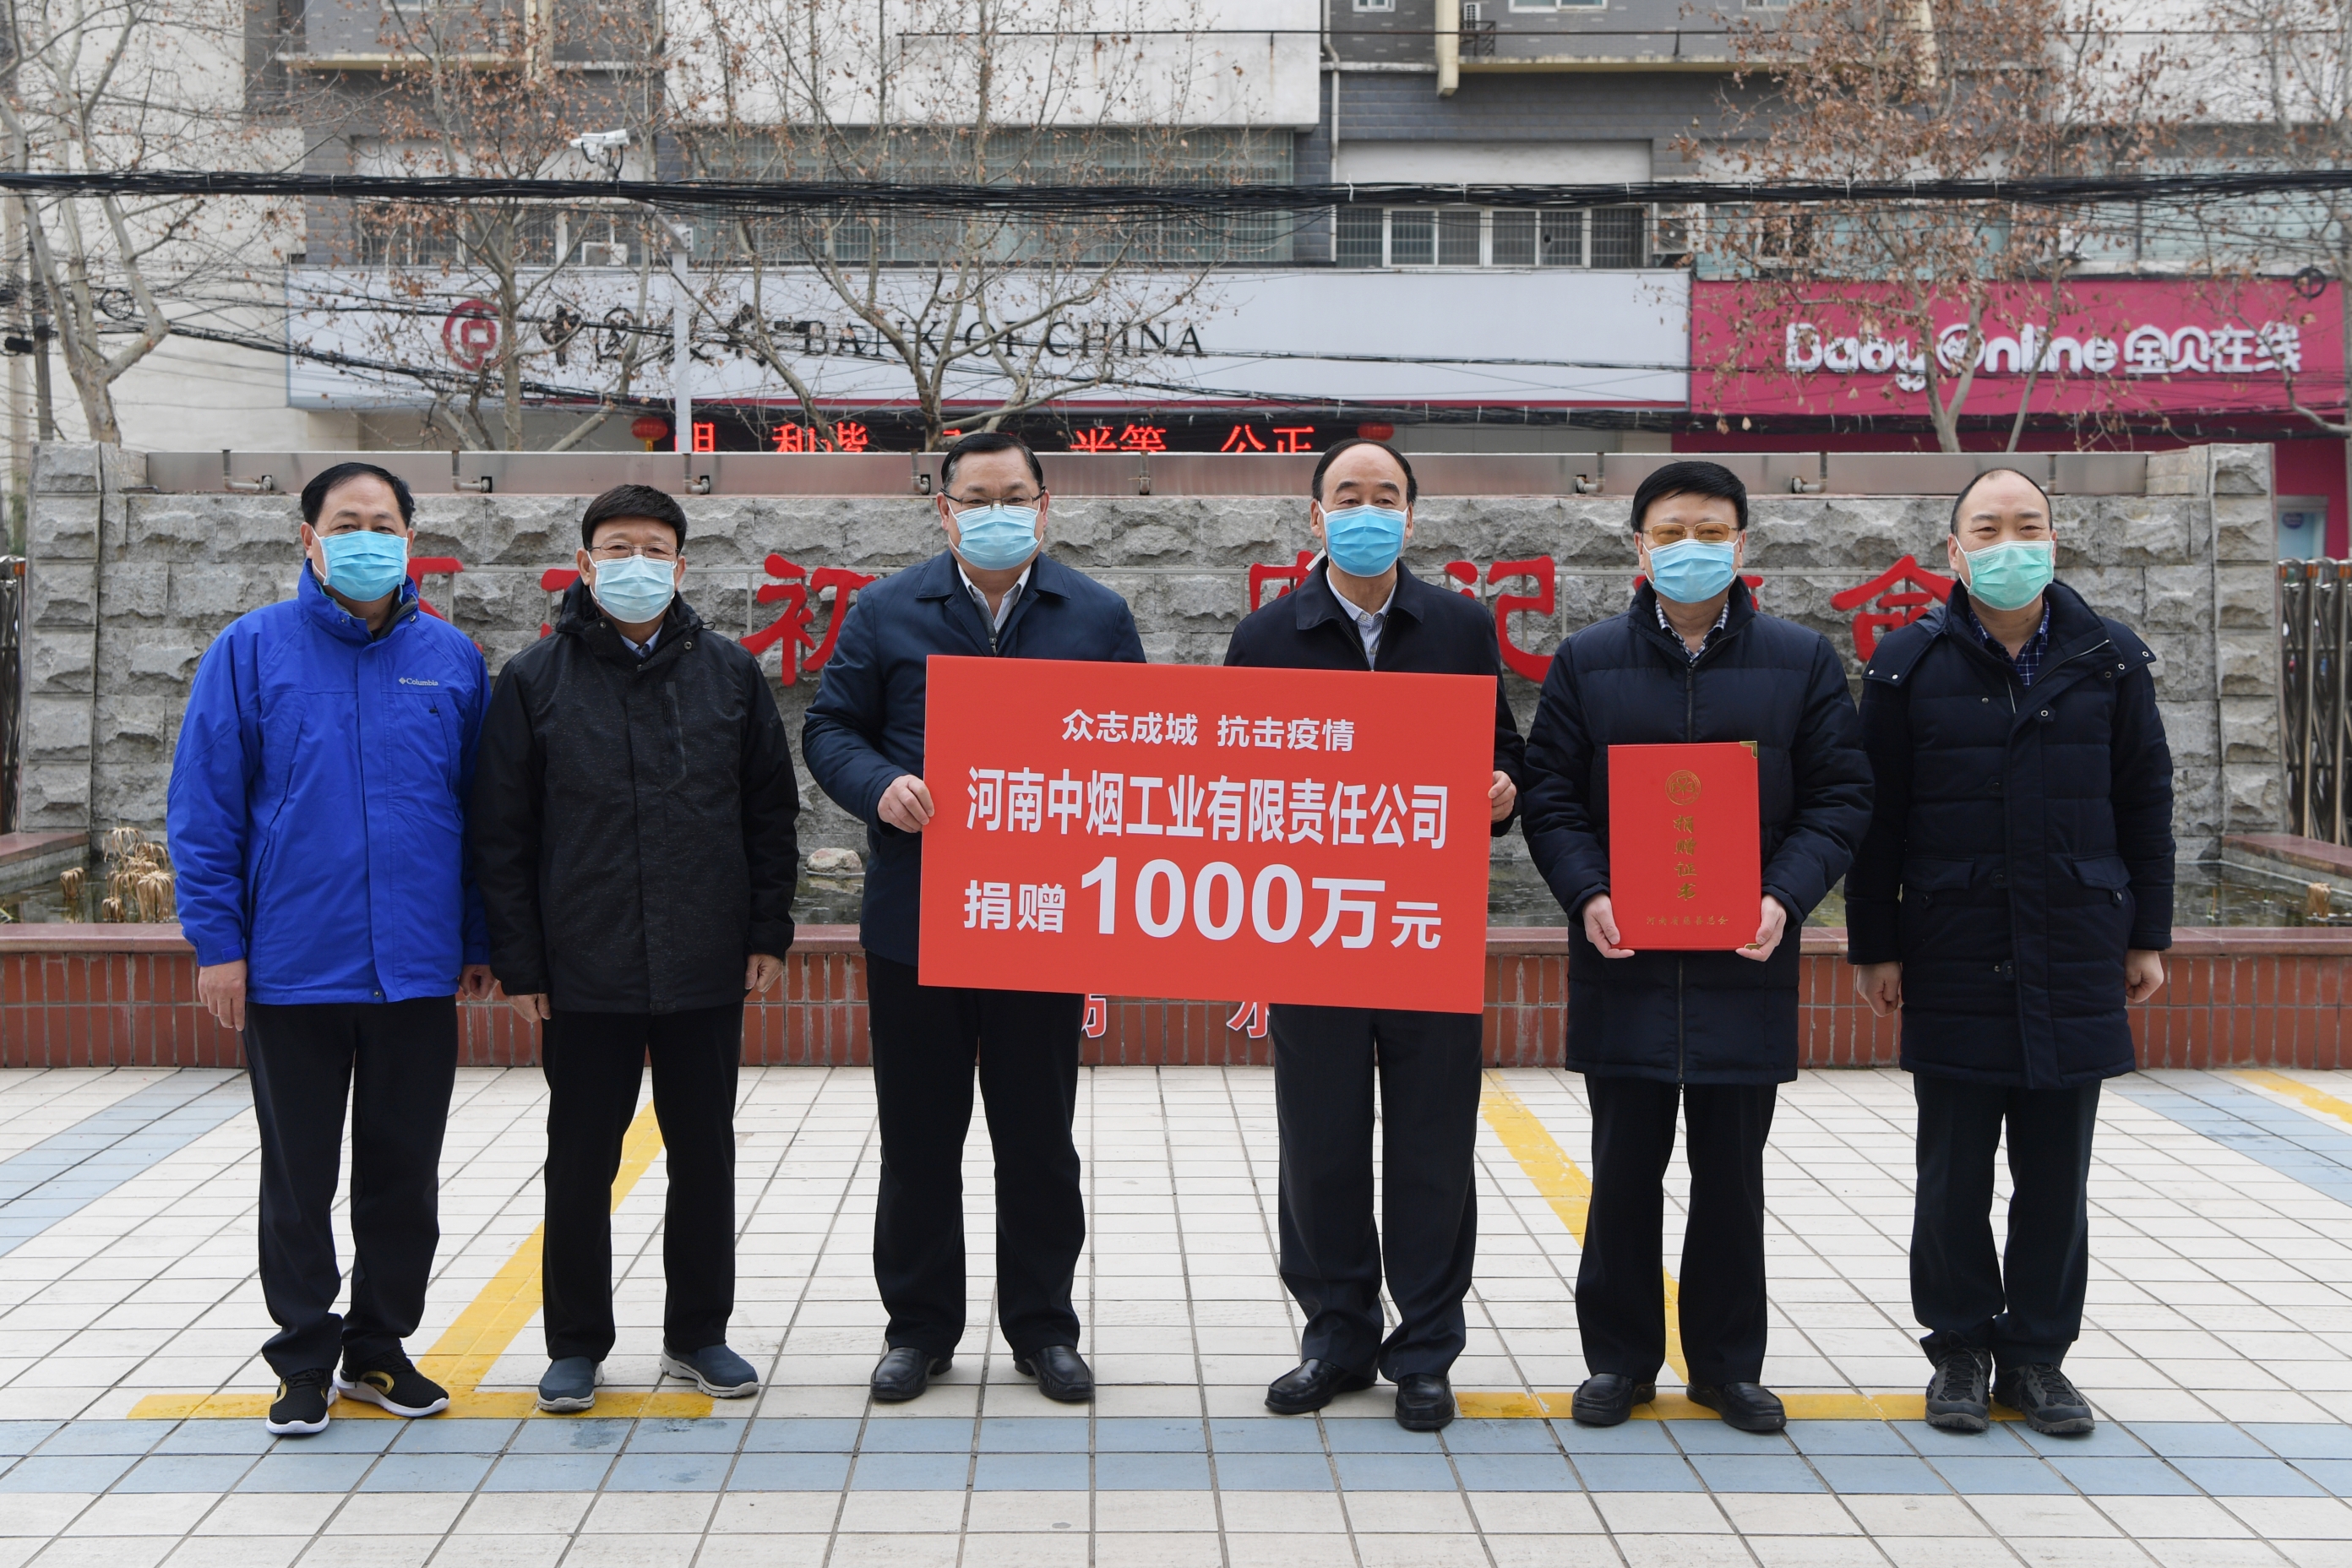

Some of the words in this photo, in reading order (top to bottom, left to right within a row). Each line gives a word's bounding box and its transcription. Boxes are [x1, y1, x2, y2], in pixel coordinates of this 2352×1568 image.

[1044, 321, 1208, 358] CHINA
[1785, 322, 1929, 394] Baby
[1935, 322, 2119, 374] Online
[2123, 320, 2302, 374] 宝贝在线
[406, 678, 438, 686] Columbia
[1062, 710, 1198, 745] 众志成城
[1217, 715, 1354, 751] 抗击疫情
[967, 767, 1447, 848] 河南中烟工业有限责任公司
[1672, 814, 1697, 901] 捐赠证书
